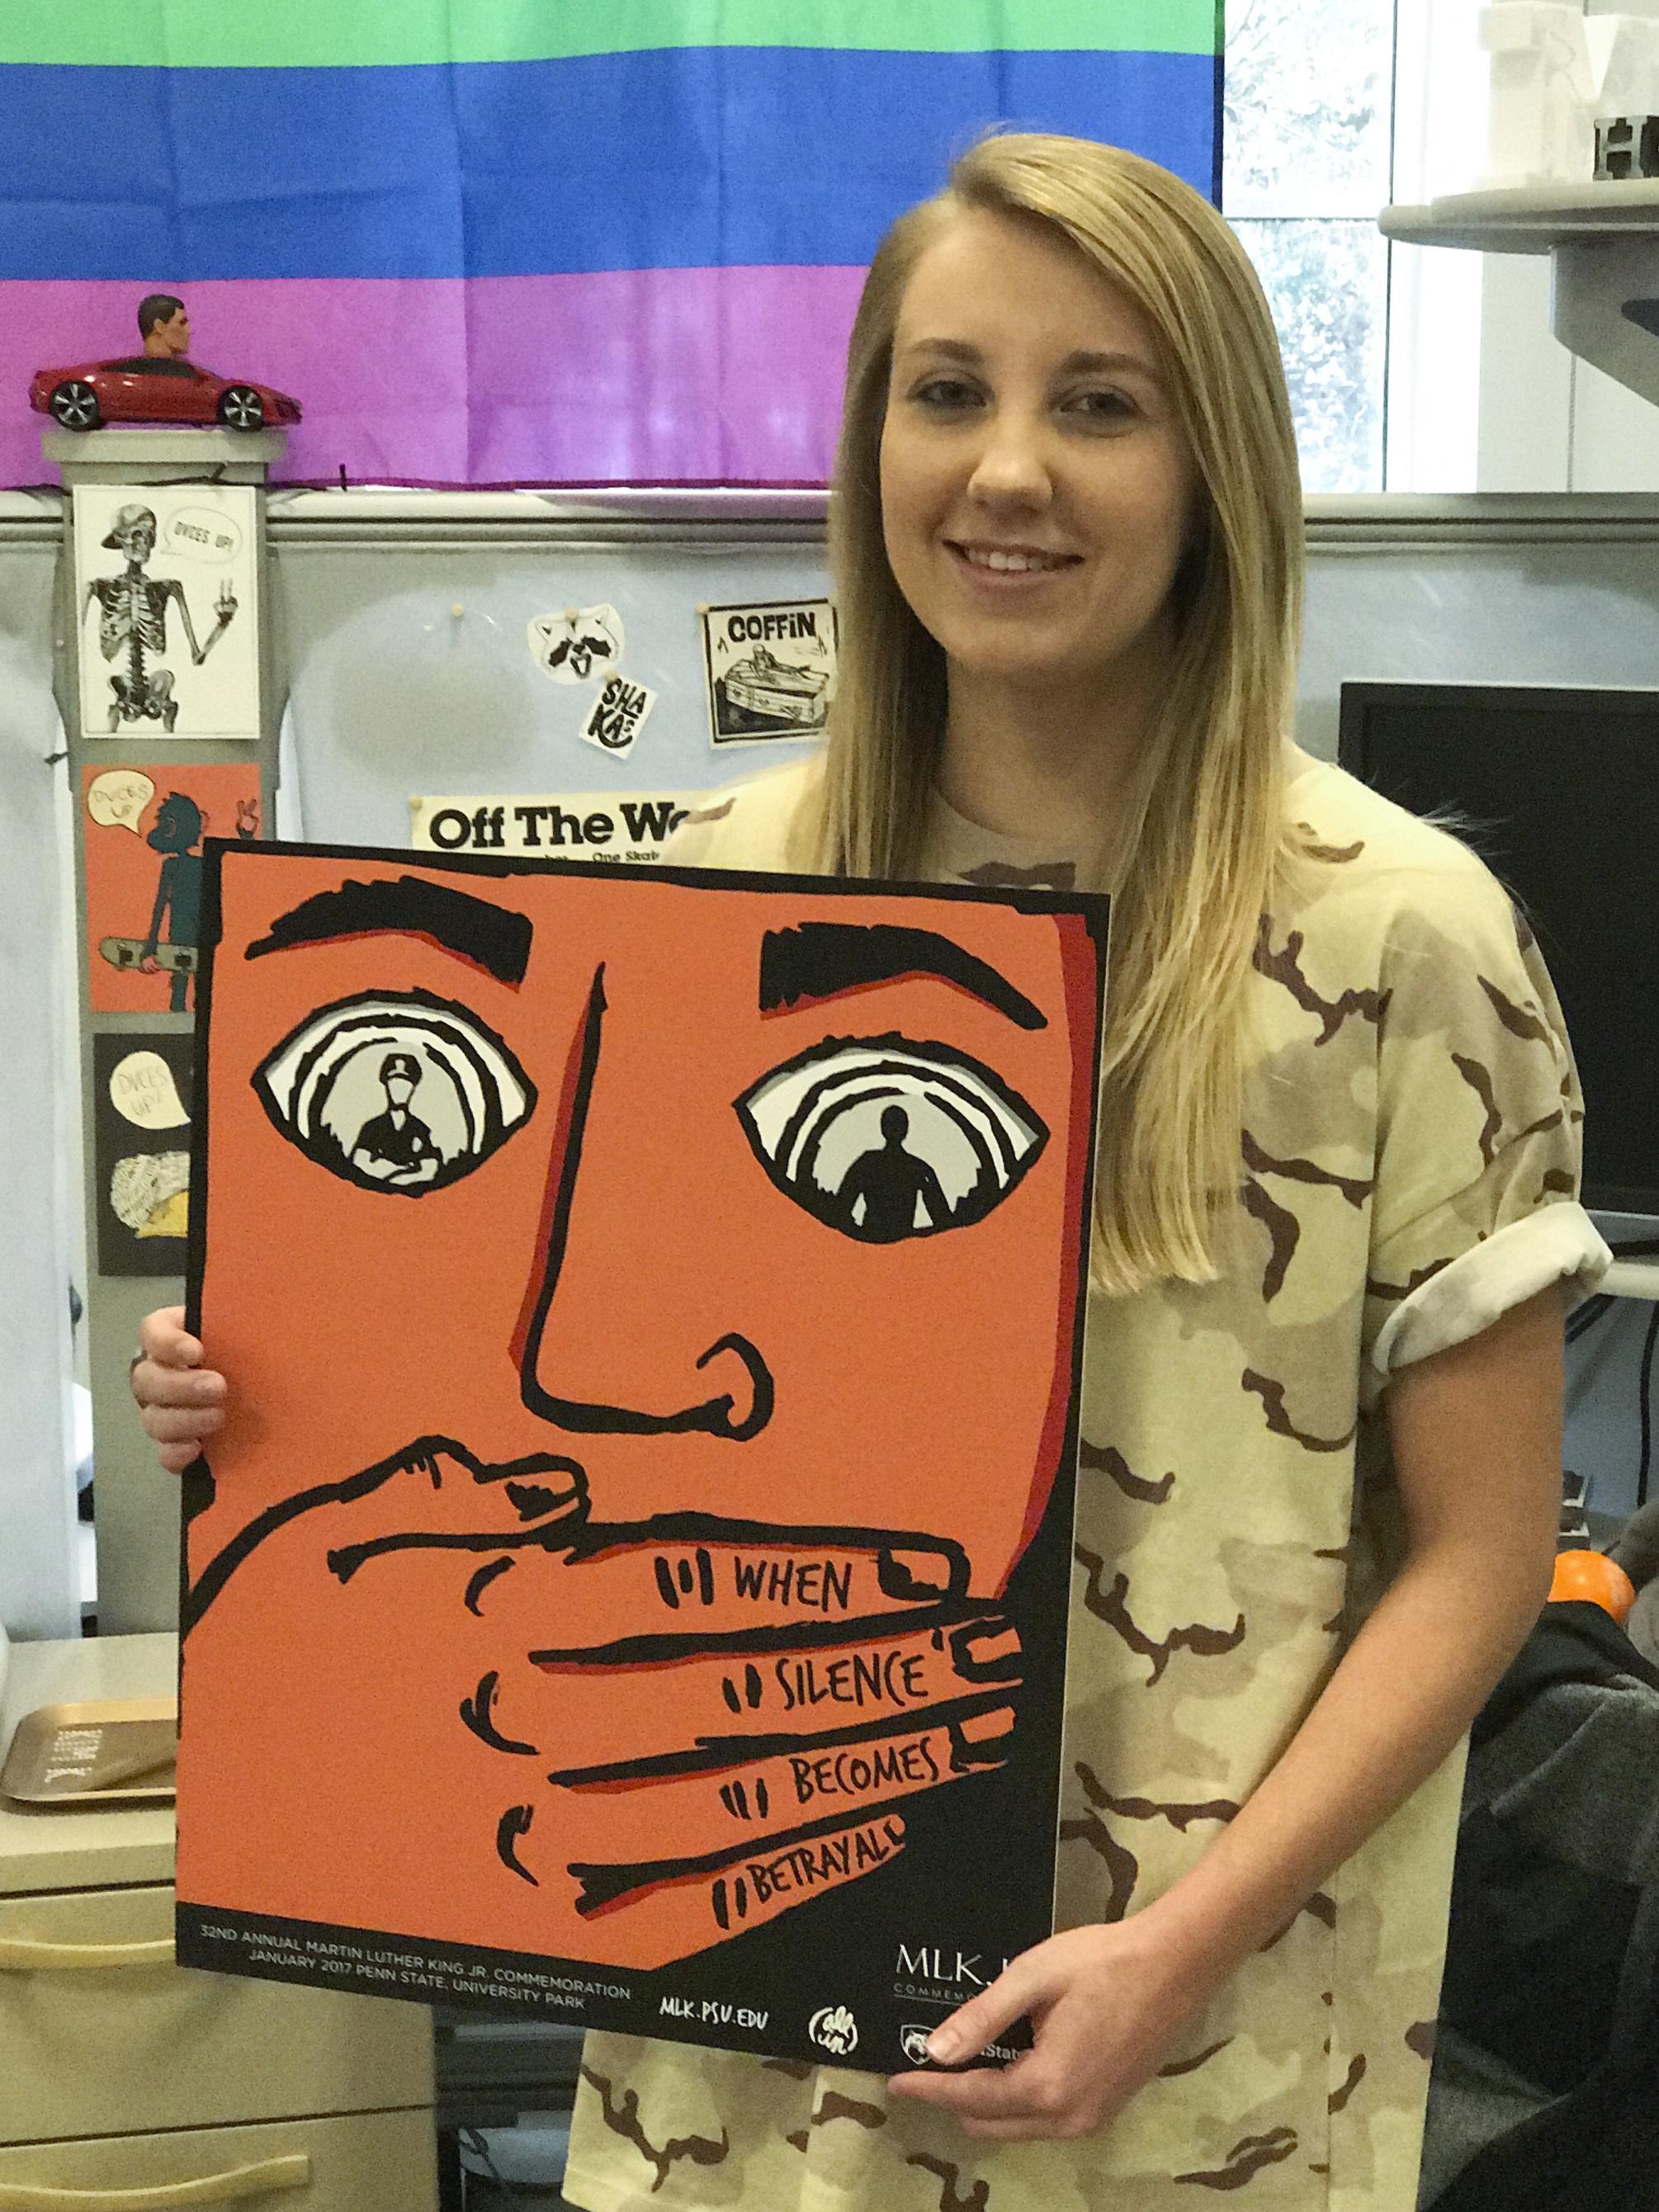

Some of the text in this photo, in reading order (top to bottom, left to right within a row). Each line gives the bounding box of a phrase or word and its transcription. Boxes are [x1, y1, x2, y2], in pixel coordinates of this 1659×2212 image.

[602, 678, 647, 719] SHA
[429, 806, 505, 849] Off
[514, 806, 614, 846] The
[592, 852, 621, 863] One
[734, 1556, 853, 1612] WHEN
[775, 1651, 929, 1711] SILENCE
[789, 1737, 938, 1803] BECOMES
[746, 1827, 891, 1904] BETRAYAL
[200, 1924, 238, 1941] 32ND
[242, 1931, 302, 1951] ANNUAL
[306, 1940, 362, 1959] MARTIN
[366, 1949, 423, 1969] LUTHER
[428, 1959, 465, 1976] KING
[494, 1969, 631, 2000] COMMEMORATION
[249, 1949, 316, 1969] JANUARY
[321, 1959, 352, 1974] 2017
[356, 1964, 396, 1981] PENN
[453, 1978, 541, 2002] UNIVERSITY
[545, 1992, 585, 2010] PARK
[659, 1996, 768, 2030] MLK.PSU.EDU
